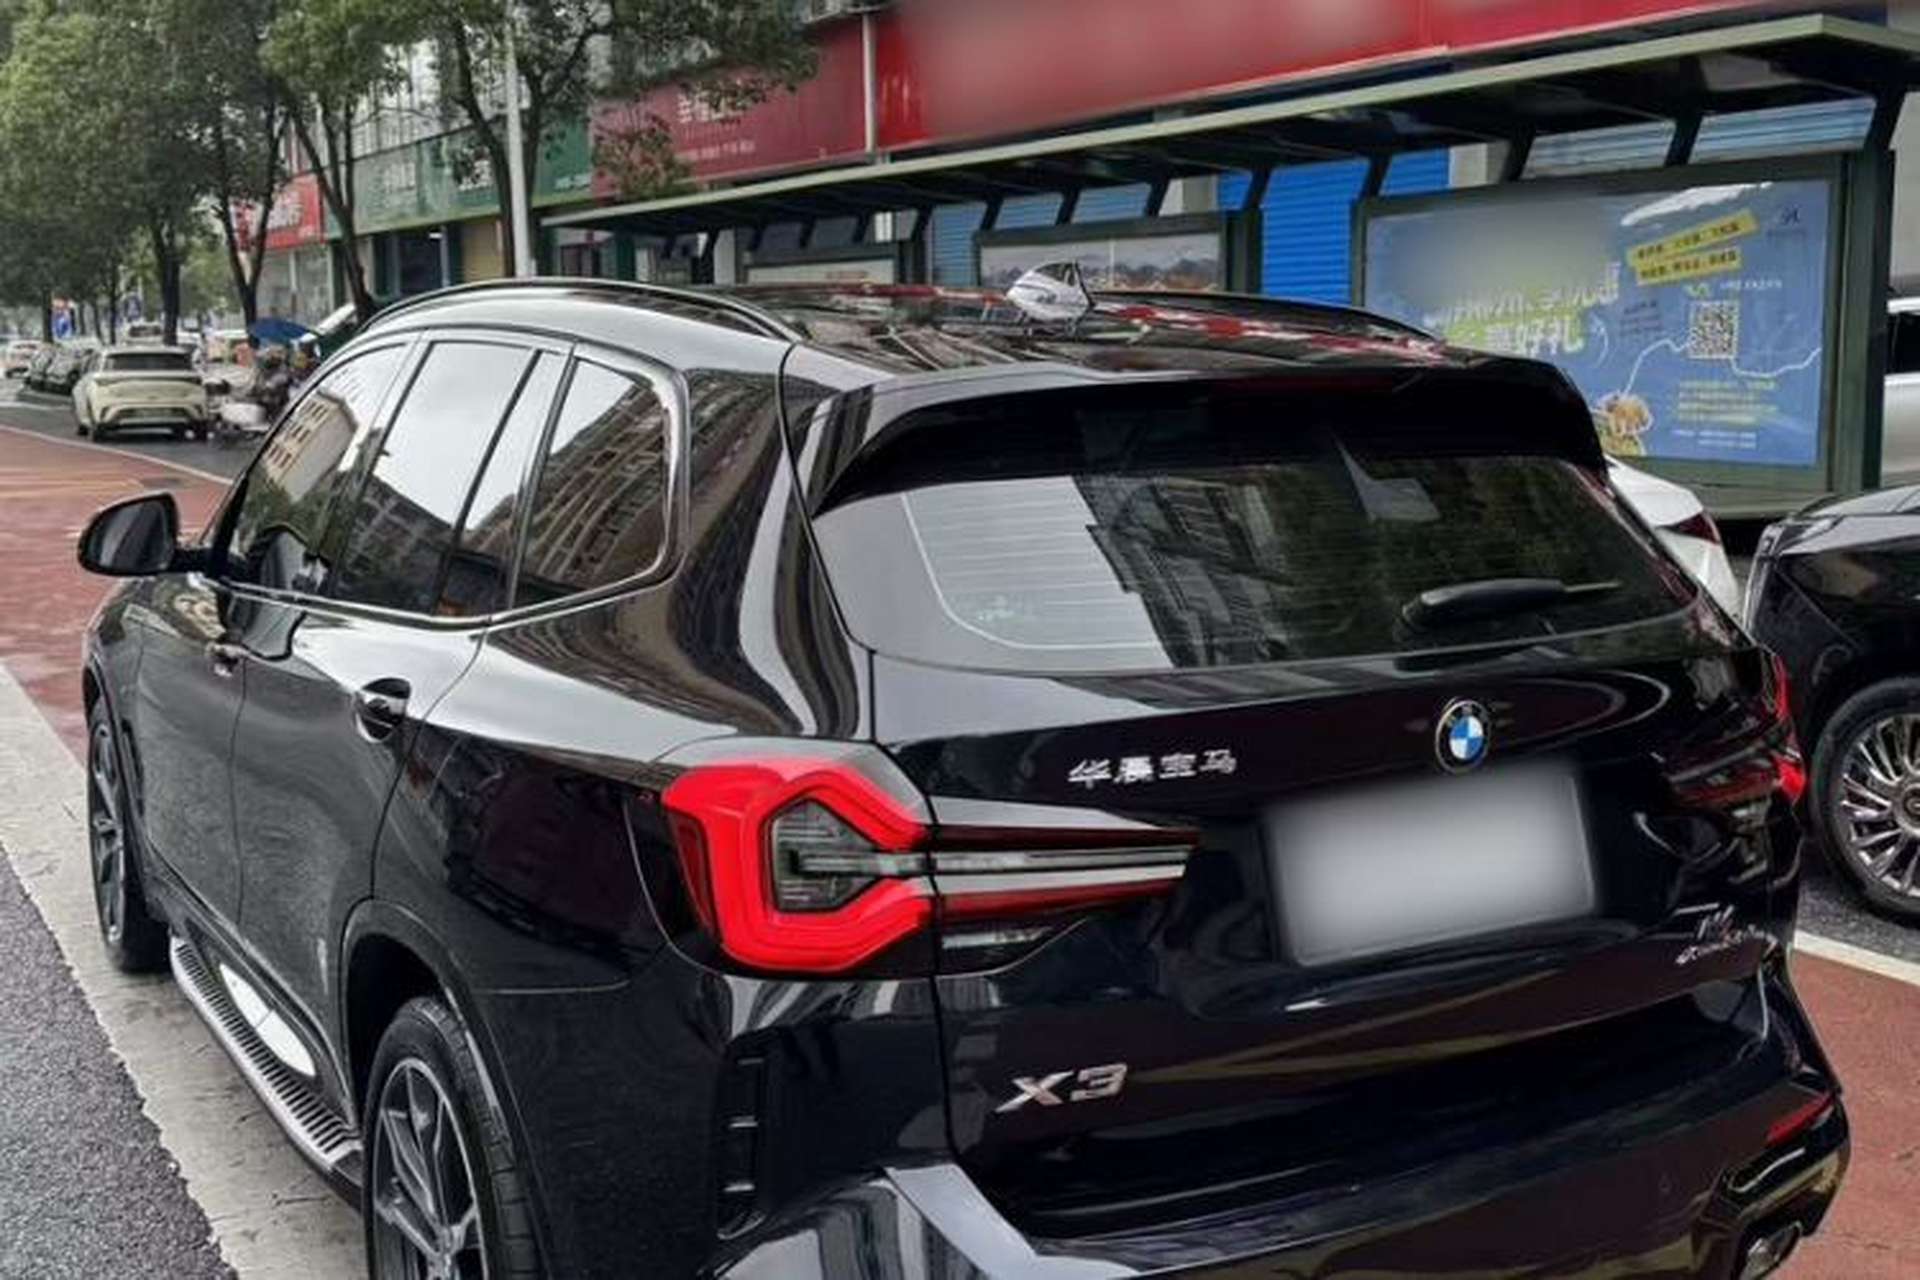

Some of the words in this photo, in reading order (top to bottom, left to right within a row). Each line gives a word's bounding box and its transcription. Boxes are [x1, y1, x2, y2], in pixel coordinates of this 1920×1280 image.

[1068, 749, 1237, 789] 华晨宝马
[995, 1063, 1128, 1113] X3
